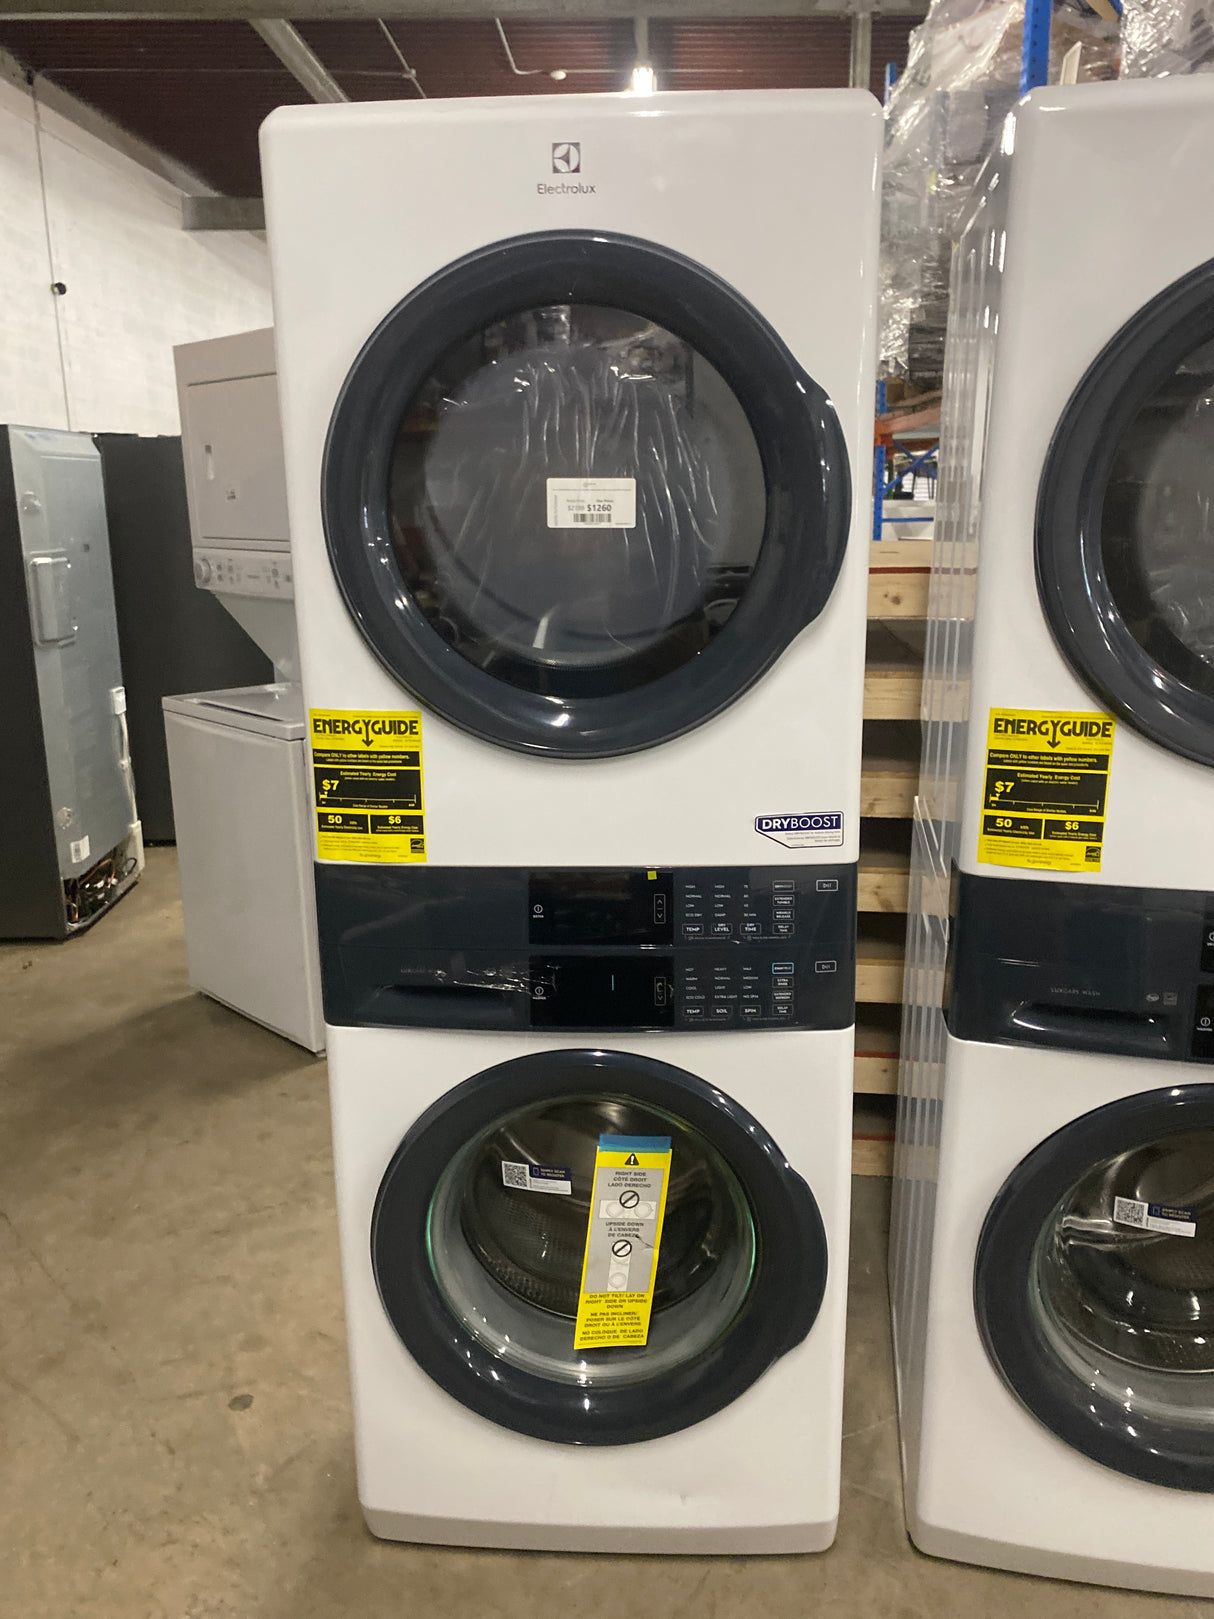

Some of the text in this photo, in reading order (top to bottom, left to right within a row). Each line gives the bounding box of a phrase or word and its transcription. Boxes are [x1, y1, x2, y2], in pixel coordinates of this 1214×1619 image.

[537, 183, 596, 194] Electrolux
[587, 504, 612, 512] $1260
[313, 718, 419, 739] ENERGYGUIDE
[994, 718, 1112, 740] ENERGYGUIDE
[322, 779, 339, 790] $7
[995, 781, 1014, 793] $7
[328, 815, 342, 824] 50
[388, 816, 401, 824] $6
[762, 816, 838, 829] DRYBOOST
[996, 818, 1012, 828] 50
[1064, 822, 1079, 831] $6
